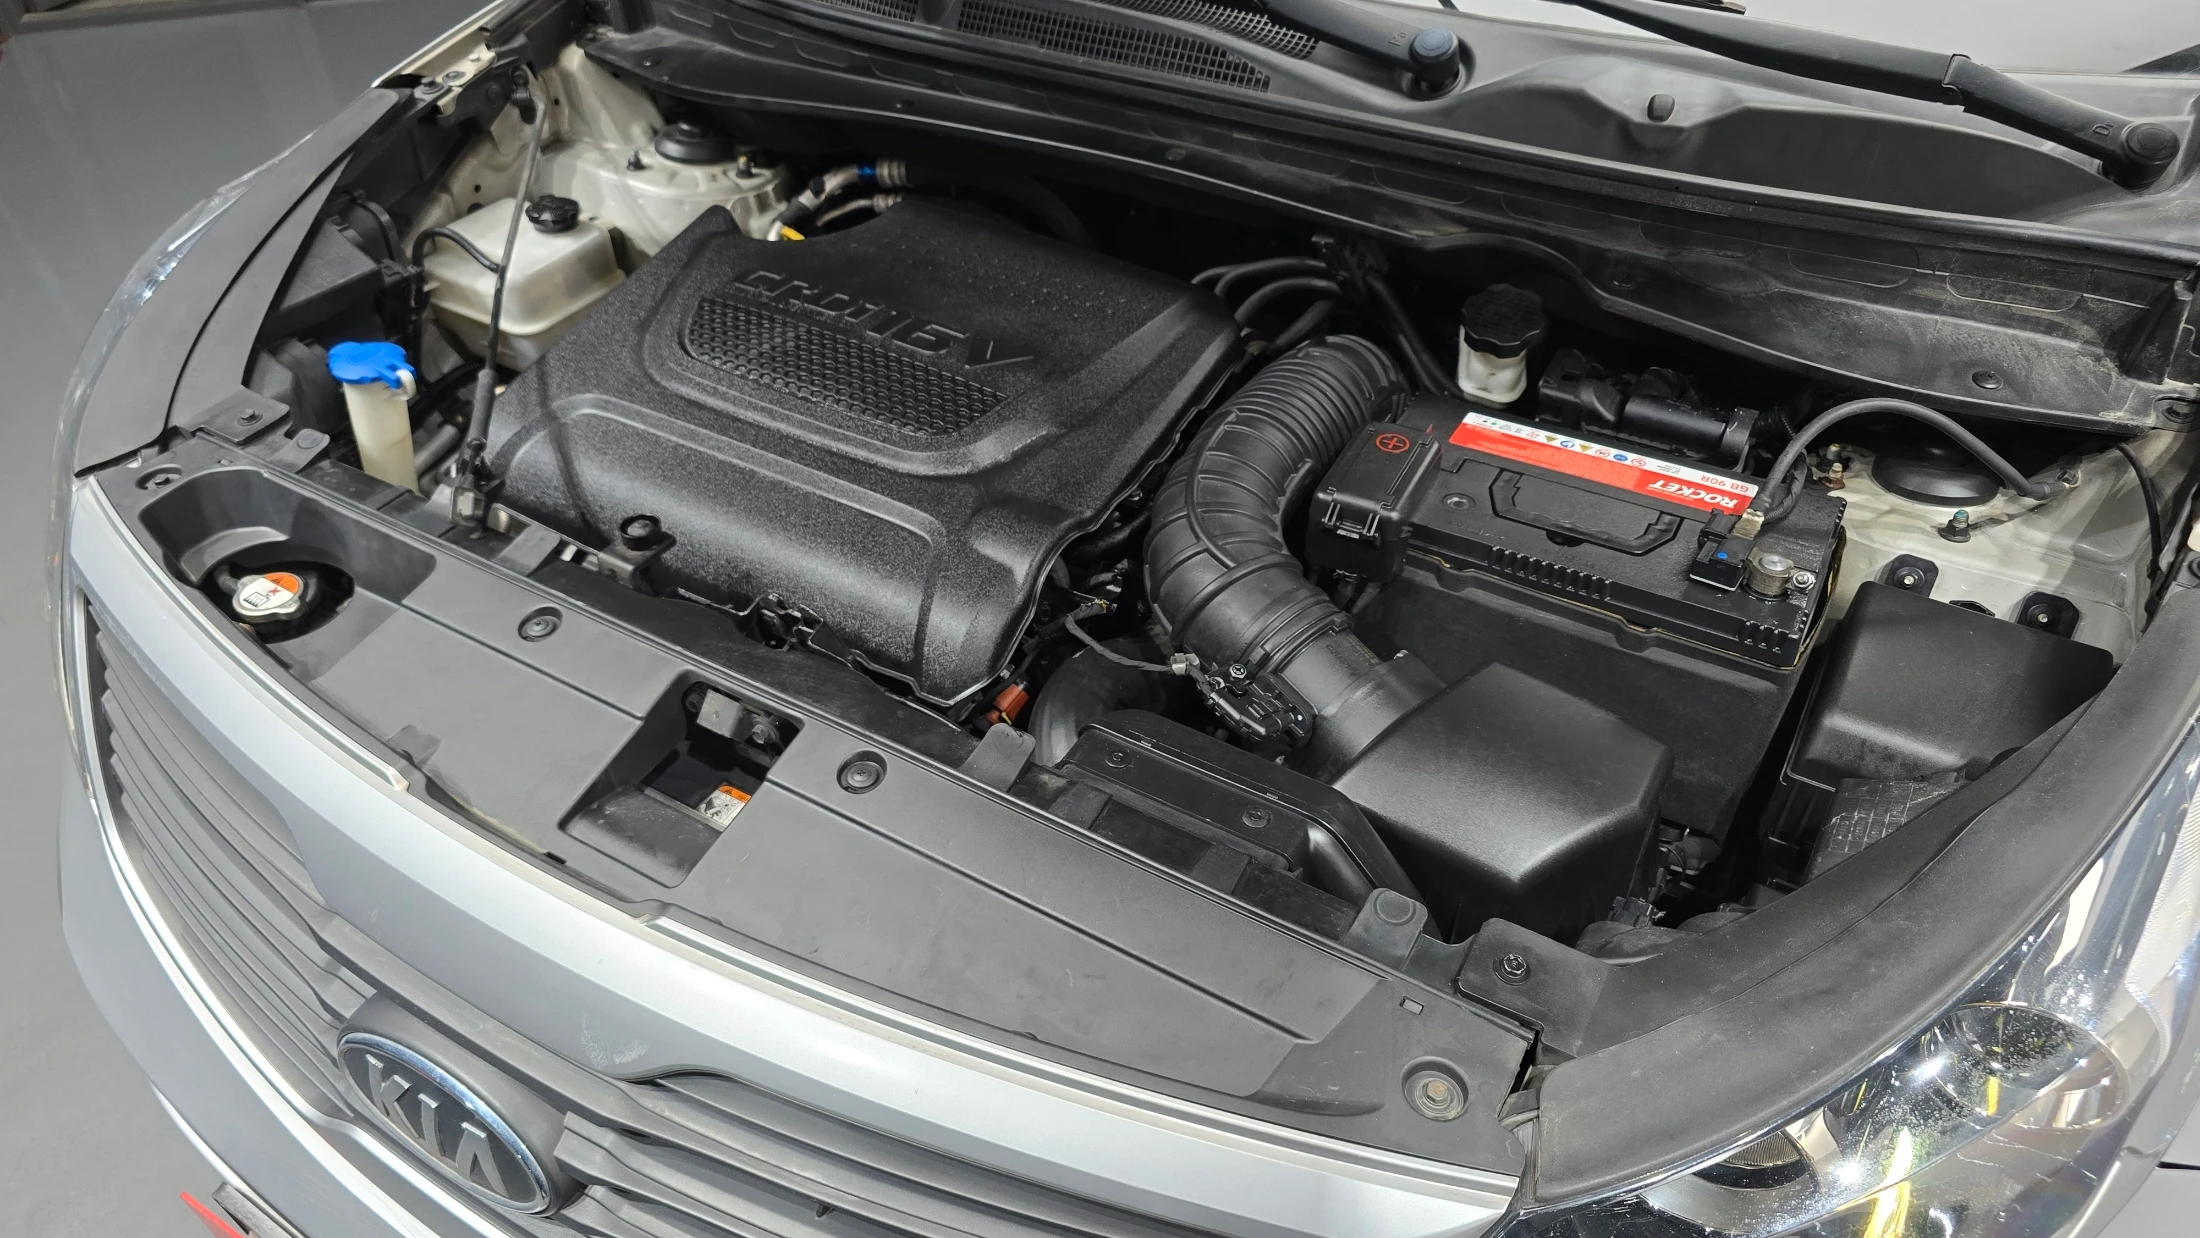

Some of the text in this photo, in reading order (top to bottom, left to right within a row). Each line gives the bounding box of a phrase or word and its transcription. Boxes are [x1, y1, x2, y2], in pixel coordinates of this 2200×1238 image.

[1648, 479, 1739, 509] ROCKET
[1701, 475, 1749, 493] GB 90R
[365, 1053, 512, 1199] KIA
